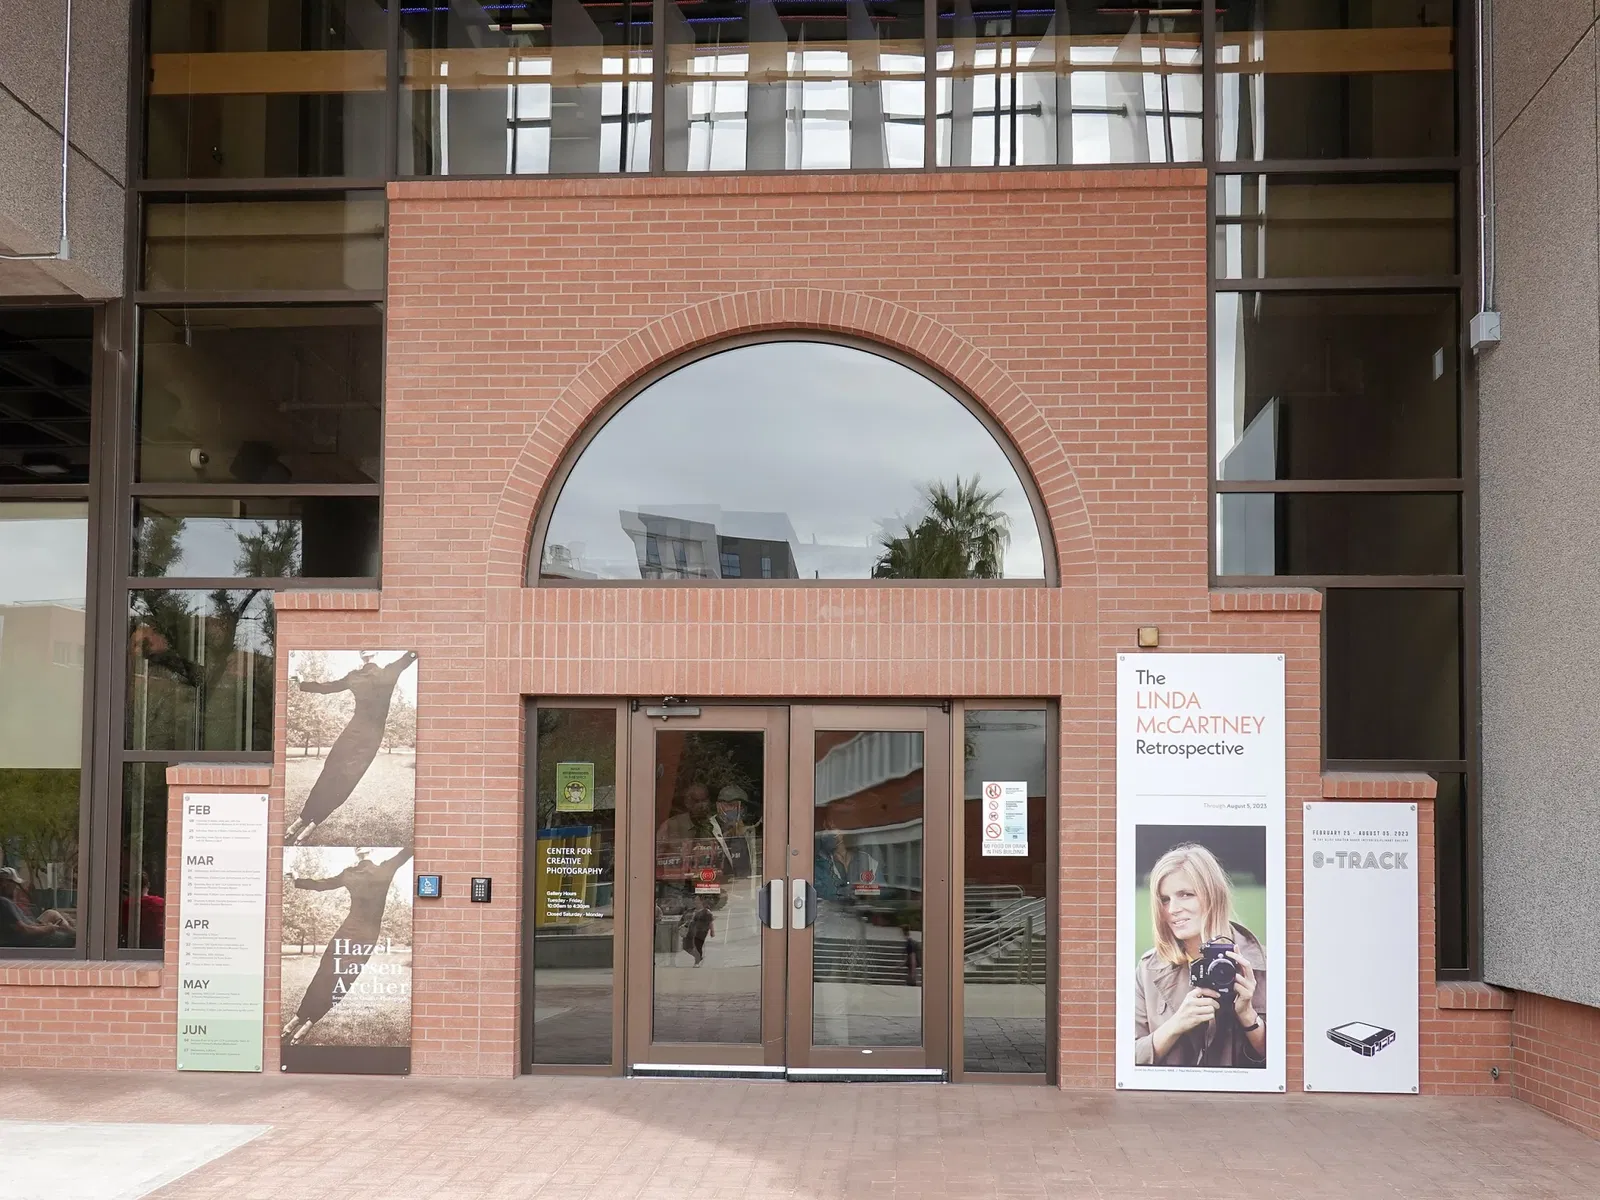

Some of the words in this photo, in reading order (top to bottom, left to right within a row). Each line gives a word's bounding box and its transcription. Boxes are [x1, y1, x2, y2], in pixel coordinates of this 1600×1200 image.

[1135, 669, 1166, 685] The
[1136, 691, 1202, 710] LINDA
[1136, 716, 1266, 735] McCARTNEY
[1136, 739, 1245, 759] Retrospective
[188, 805, 211, 815] FEB
[546, 847, 575, 855] CENTER
[577, 847, 593, 855] FOR
[186, 855, 214, 866] MAR
[546, 857, 582, 865] CREATIVE
[1312, 850, 1409, 870] 8-TRACK
[546, 867, 604, 875] PHOTOGRAPHY
[585, 911, 604, 919] Monday
[184, 919, 210, 929] APR
[333, 937, 392, 956] Hazel
[333, 957, 402, 975] Larsen
[183, 979, 210, 989] MAY
[331, 976, 409, 995] Archer
[182, 1025, 207, 1035] JUN
